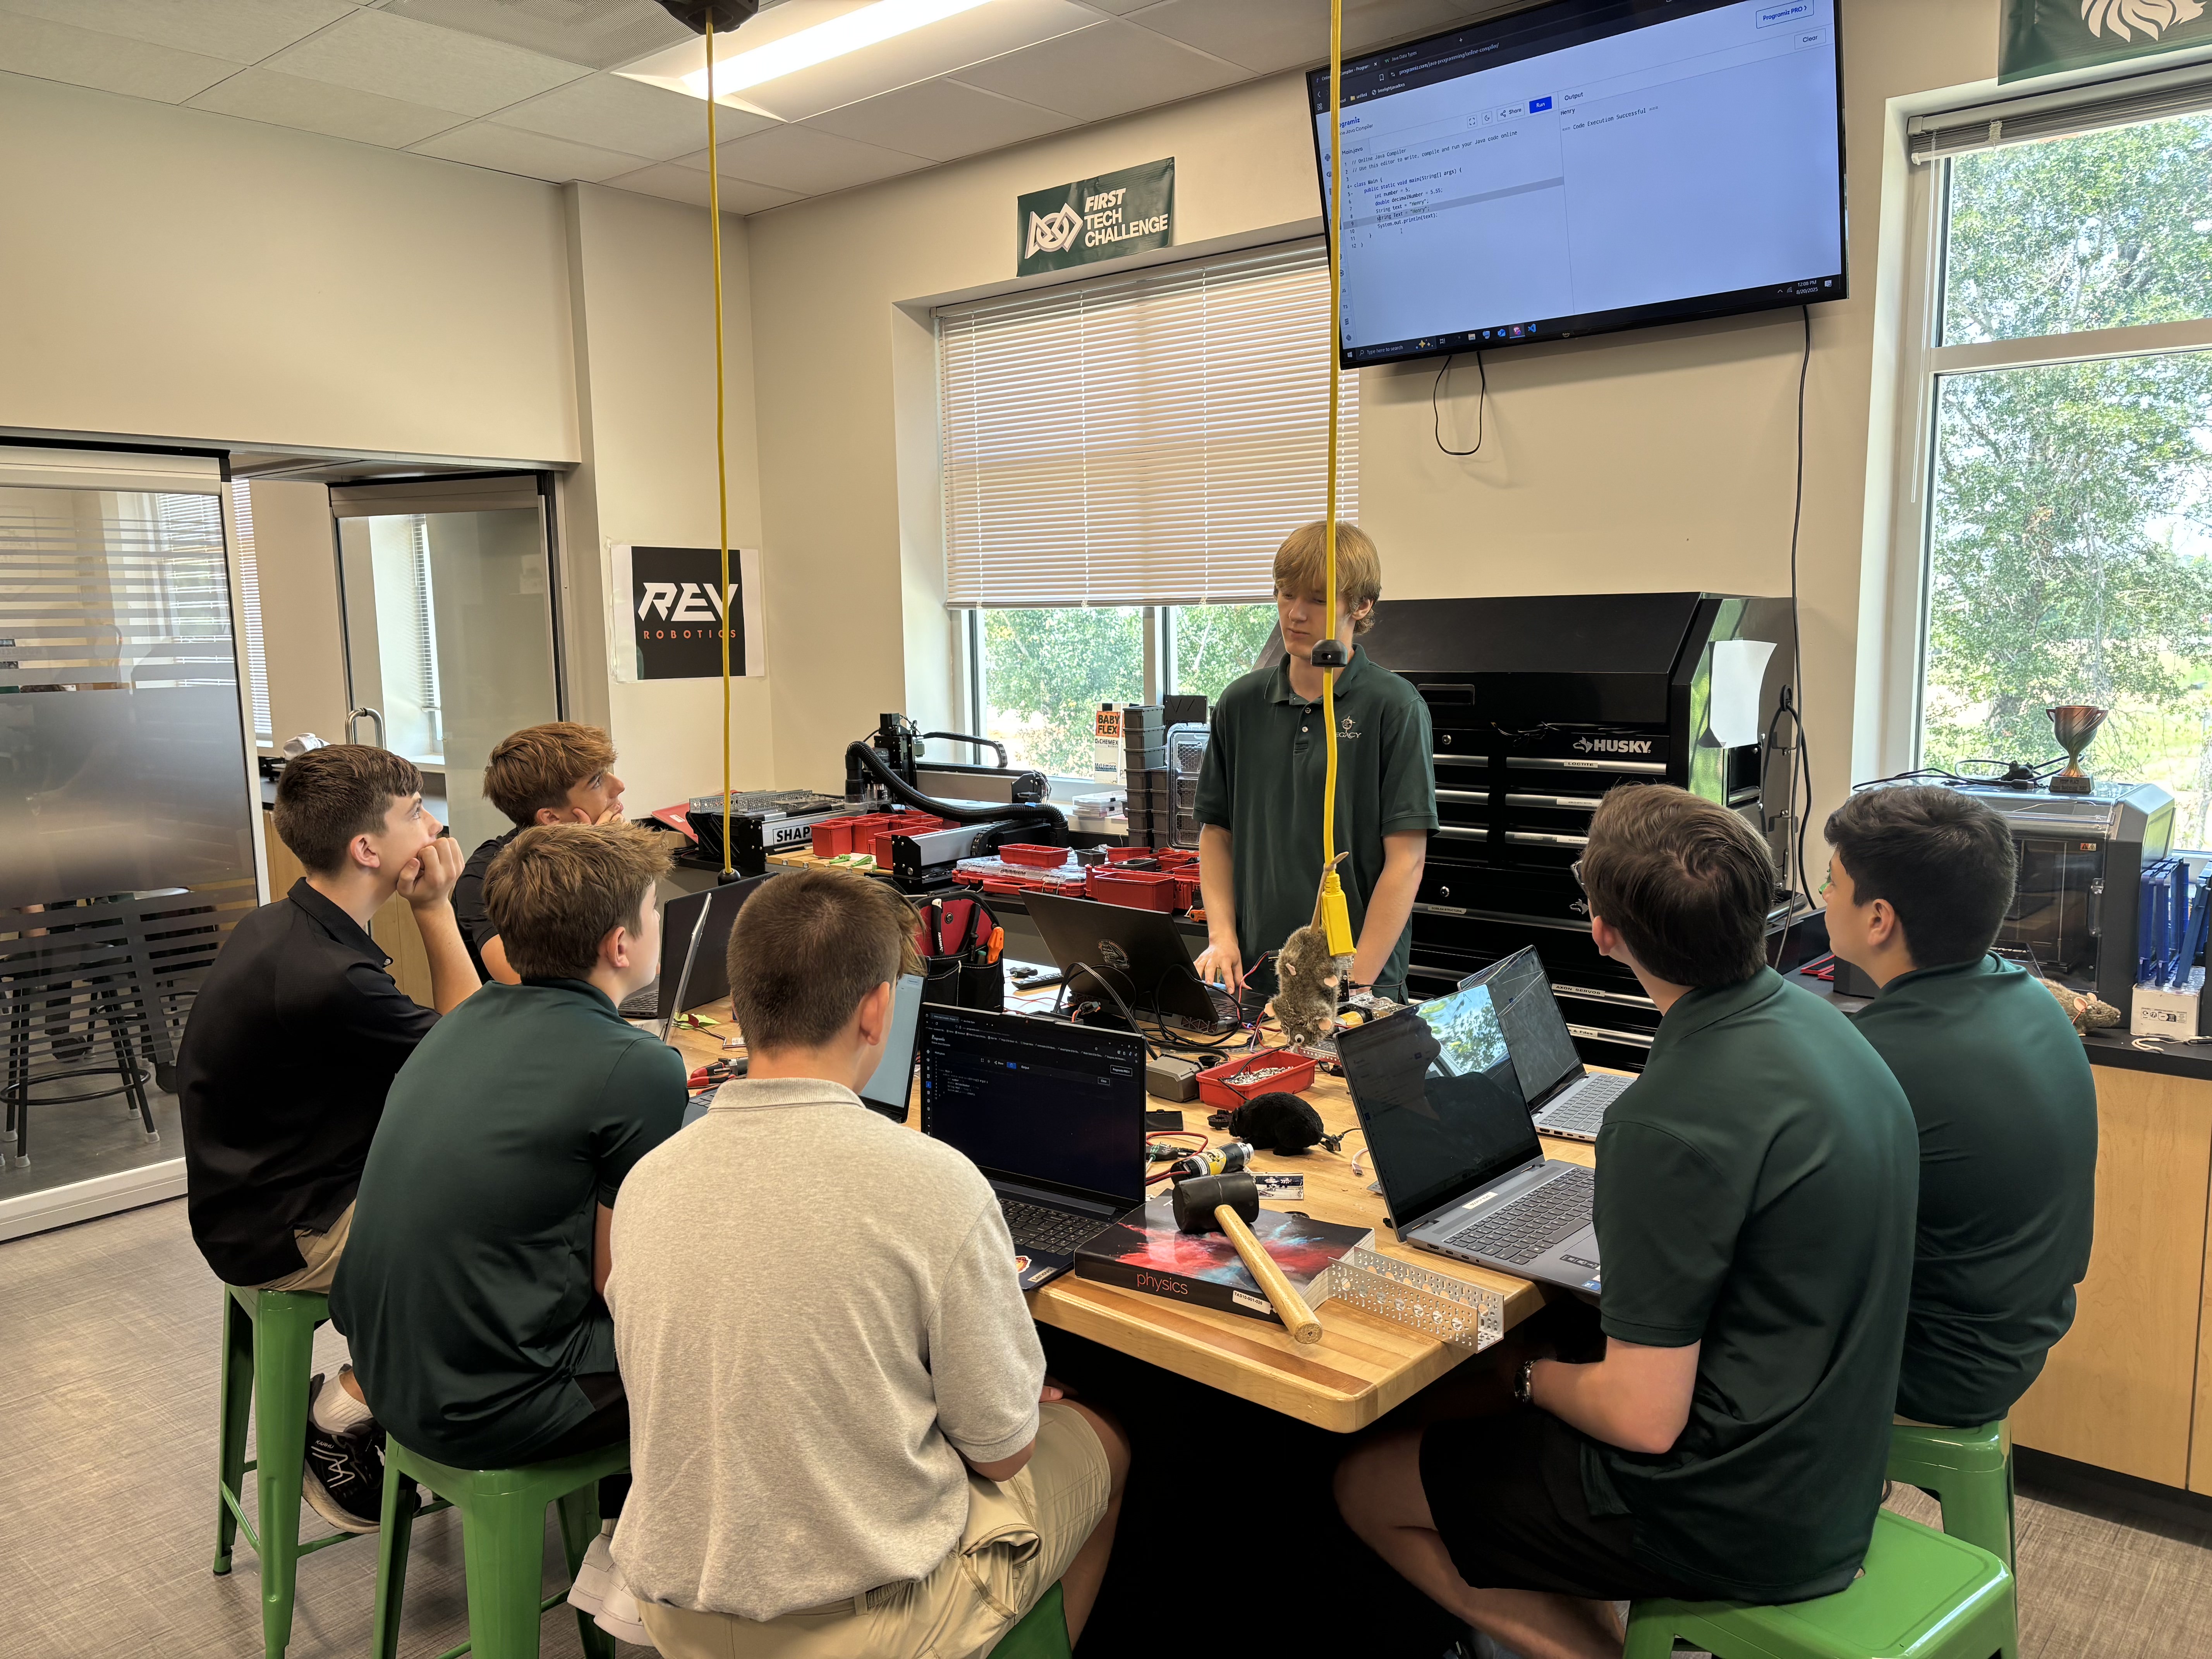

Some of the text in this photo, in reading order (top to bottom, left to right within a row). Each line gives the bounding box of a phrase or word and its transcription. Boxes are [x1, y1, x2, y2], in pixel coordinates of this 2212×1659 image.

[1763, 10, 1790, 21] Programiz
[1564, 92, 1583, 101] Output
[1561, 108, 1575, 116] Henry
[1587, 116, 1614, 127] Execution
[1616, 108, 1647, 120] Successful
[1387, 148, 1407, 156] Compiler
[1422, 148, 1439, 157] compile
[1364, 185, 1379, 194] public
[1444, 168, 1456, 177] args)
[1084, 187, 1127, 213] FIRST
[1392, 192, 1423, 203] decimalNumber
[1084, 208, 1122, 230] TECH
[1085, 213, 1168, 247] CHALLENGE
[638, 582, 738, 621] REV
[1098, 714, 1120, 724] BABY
[1098, 725, 1117, 734] FLEX
[1594, 739, 1652, 753] HUSKY
[776, 826, 810, 842] SHAP
[1032, 1268, 1052, 1281] Lenovo
[1137, 1272, 1188, 1295] physics
